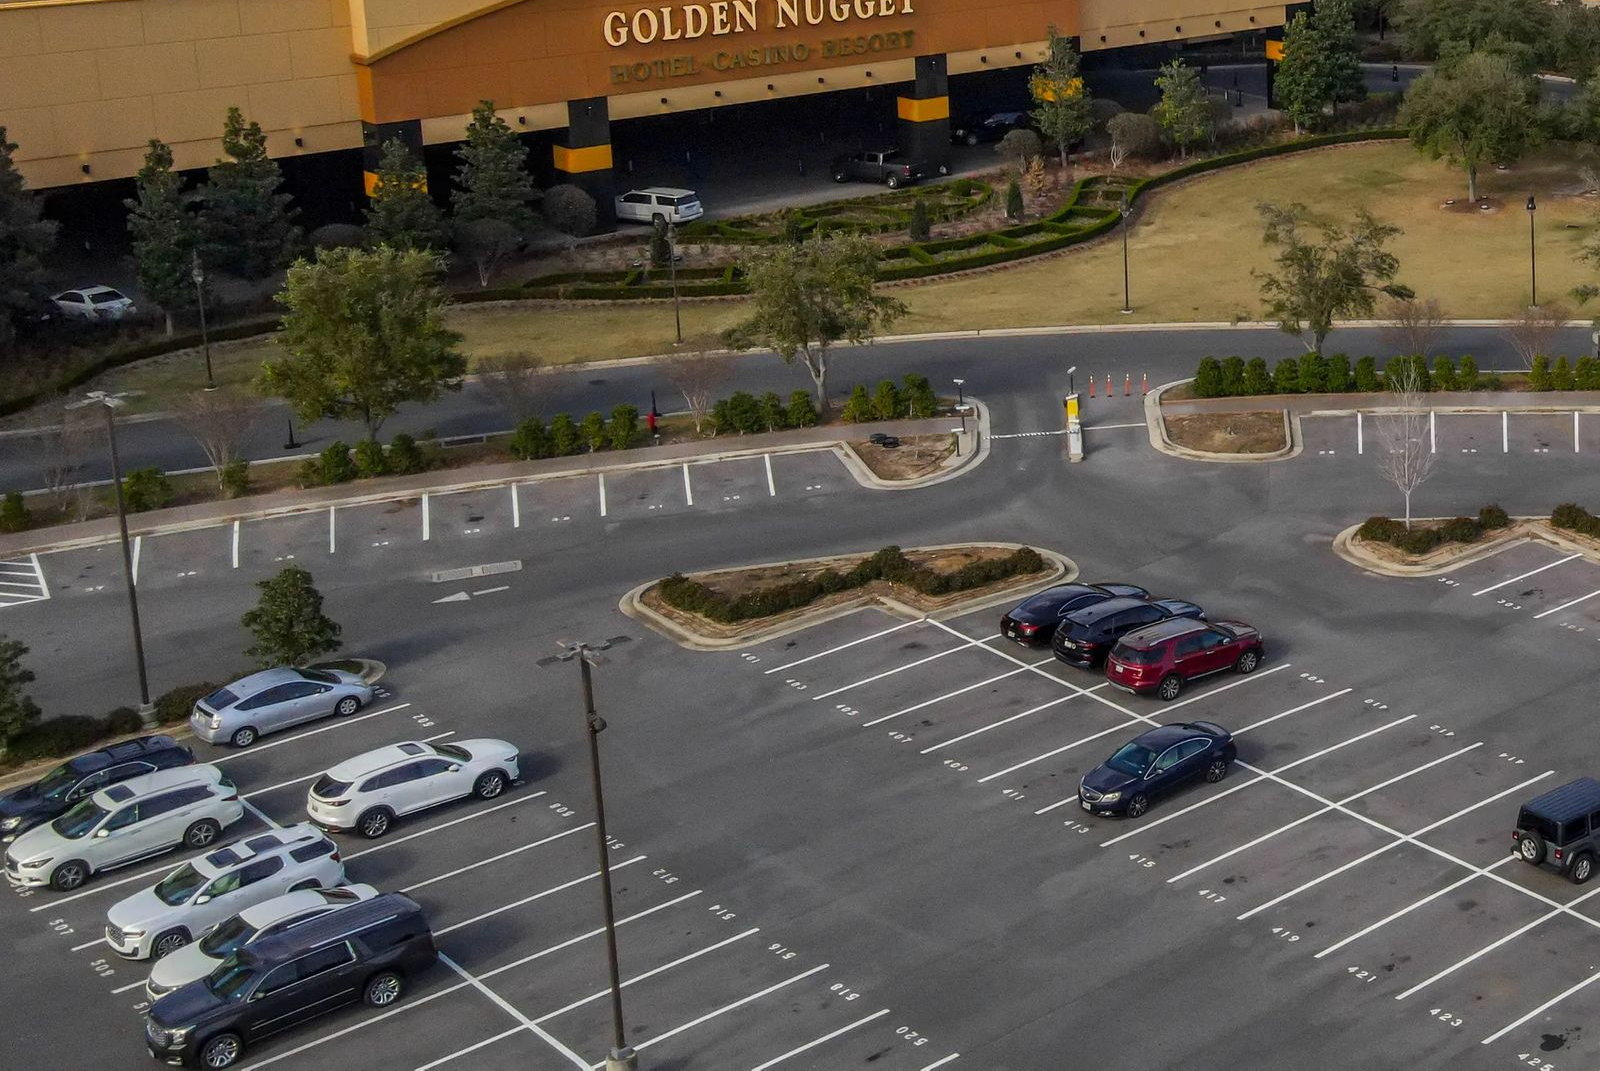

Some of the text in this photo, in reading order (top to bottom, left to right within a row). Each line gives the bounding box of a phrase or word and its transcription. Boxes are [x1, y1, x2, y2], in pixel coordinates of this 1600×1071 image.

[610, 30, 916, 85] HOTEL CASINO RESORT
[1429, 724, 1455, 736] 412
[1498, 752, 1525, 764] 414
[1002, 788, 1025, 801] 411
[1063, 820, 1090, 834] 413
[1128, 854, 1156, 868] 415
[652, 868, 679, 884] 512
[1198, 889, 1227, 903] 417
[48, 918, 75, 936] 507
[1271, 927, 1300, 942] 419
[1347, 966, 1377, 983] 421
[1429, 1008, 1463, 1027] 423
[895, 1026, 929, 1046] 520
[1517, 1053, 1555, 1071] 425
